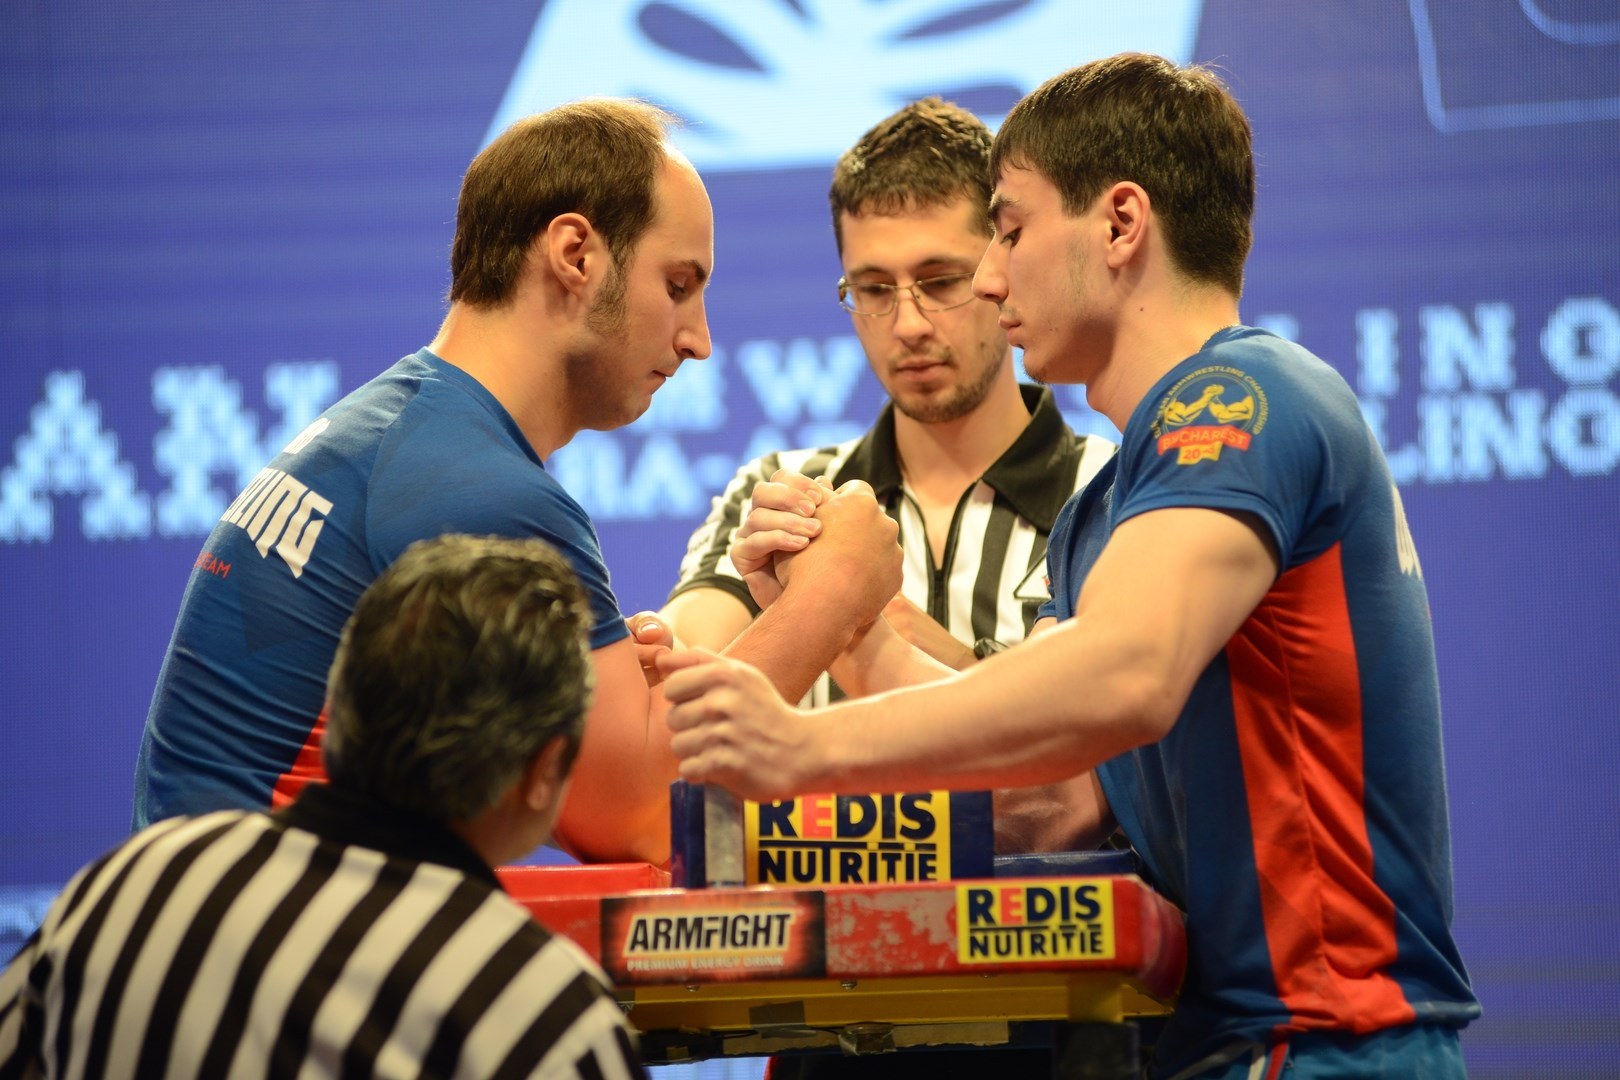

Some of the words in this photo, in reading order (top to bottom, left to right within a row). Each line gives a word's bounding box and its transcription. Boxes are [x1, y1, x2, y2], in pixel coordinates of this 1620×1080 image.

[1162, 429, 1247, 450] BUCHAREST
[759, 793, 936, 840] REDIS
[759, 846, 937, 883] NUTRITIE
[968, 885, 1101, 925] REDIS
[629, 914, 791, 951] ARMFIGHT
[970, 928, 1103, 957] NUTRITIE
[627, 958, 687, 971] PREMIUM
[691, 956, 739, 970] ENERGY
[743, 955, 784, 967] DRINK
